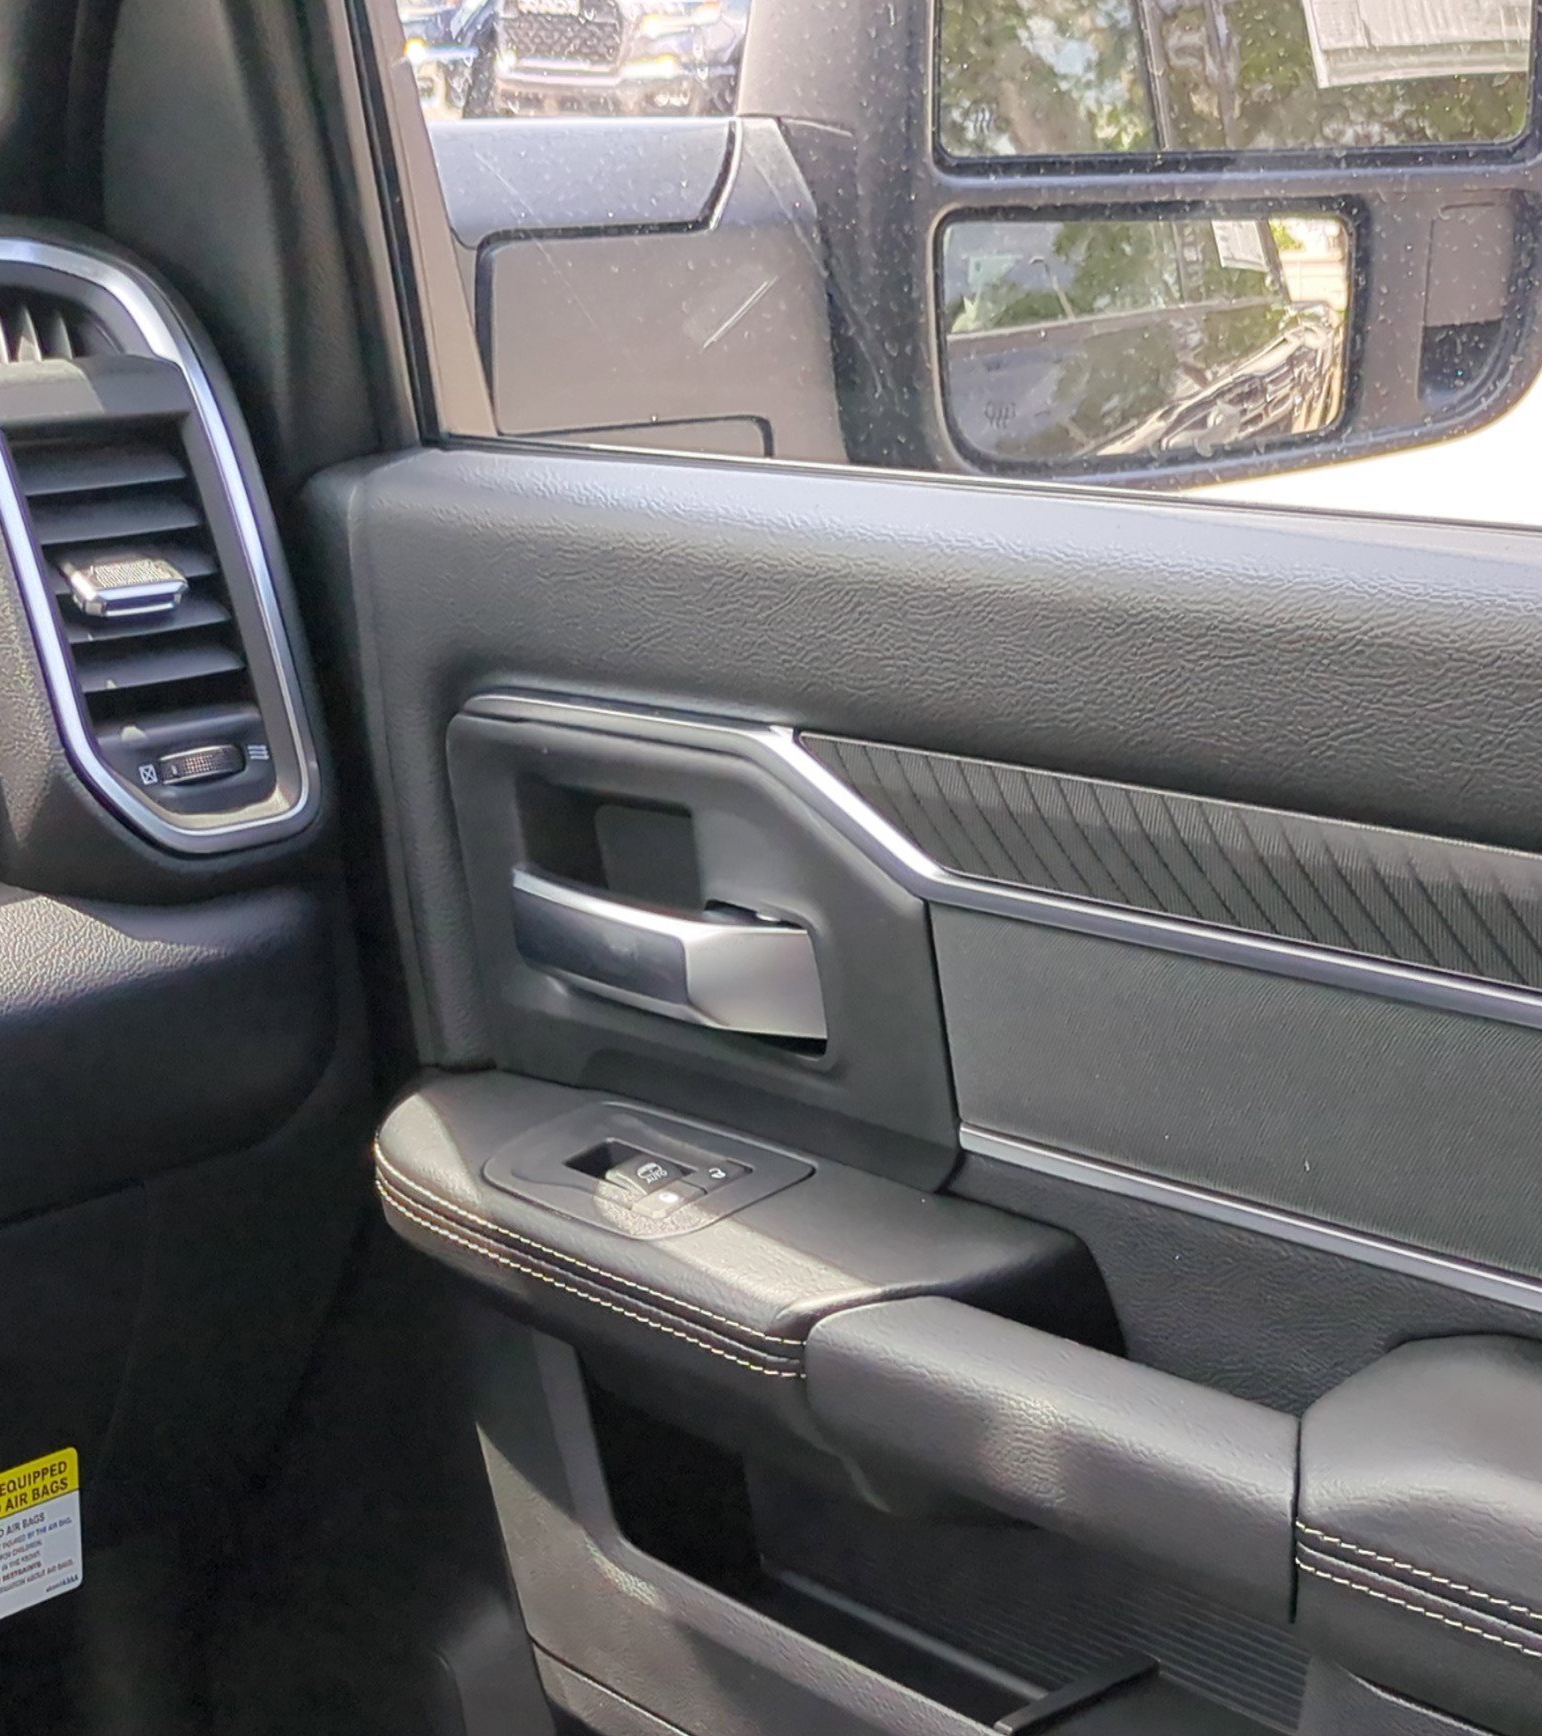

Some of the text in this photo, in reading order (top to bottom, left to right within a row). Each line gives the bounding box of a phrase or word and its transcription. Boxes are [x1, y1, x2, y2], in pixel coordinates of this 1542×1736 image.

[0, 1461, 67, 1497] EQUIPPED
[5, 1491, 28, 1511] AIR
[32, 1476, 68, 1501] BAGS
[6, 1522, 20, 1535] AIR
[22, 1512, 45, 1528] BAGS
